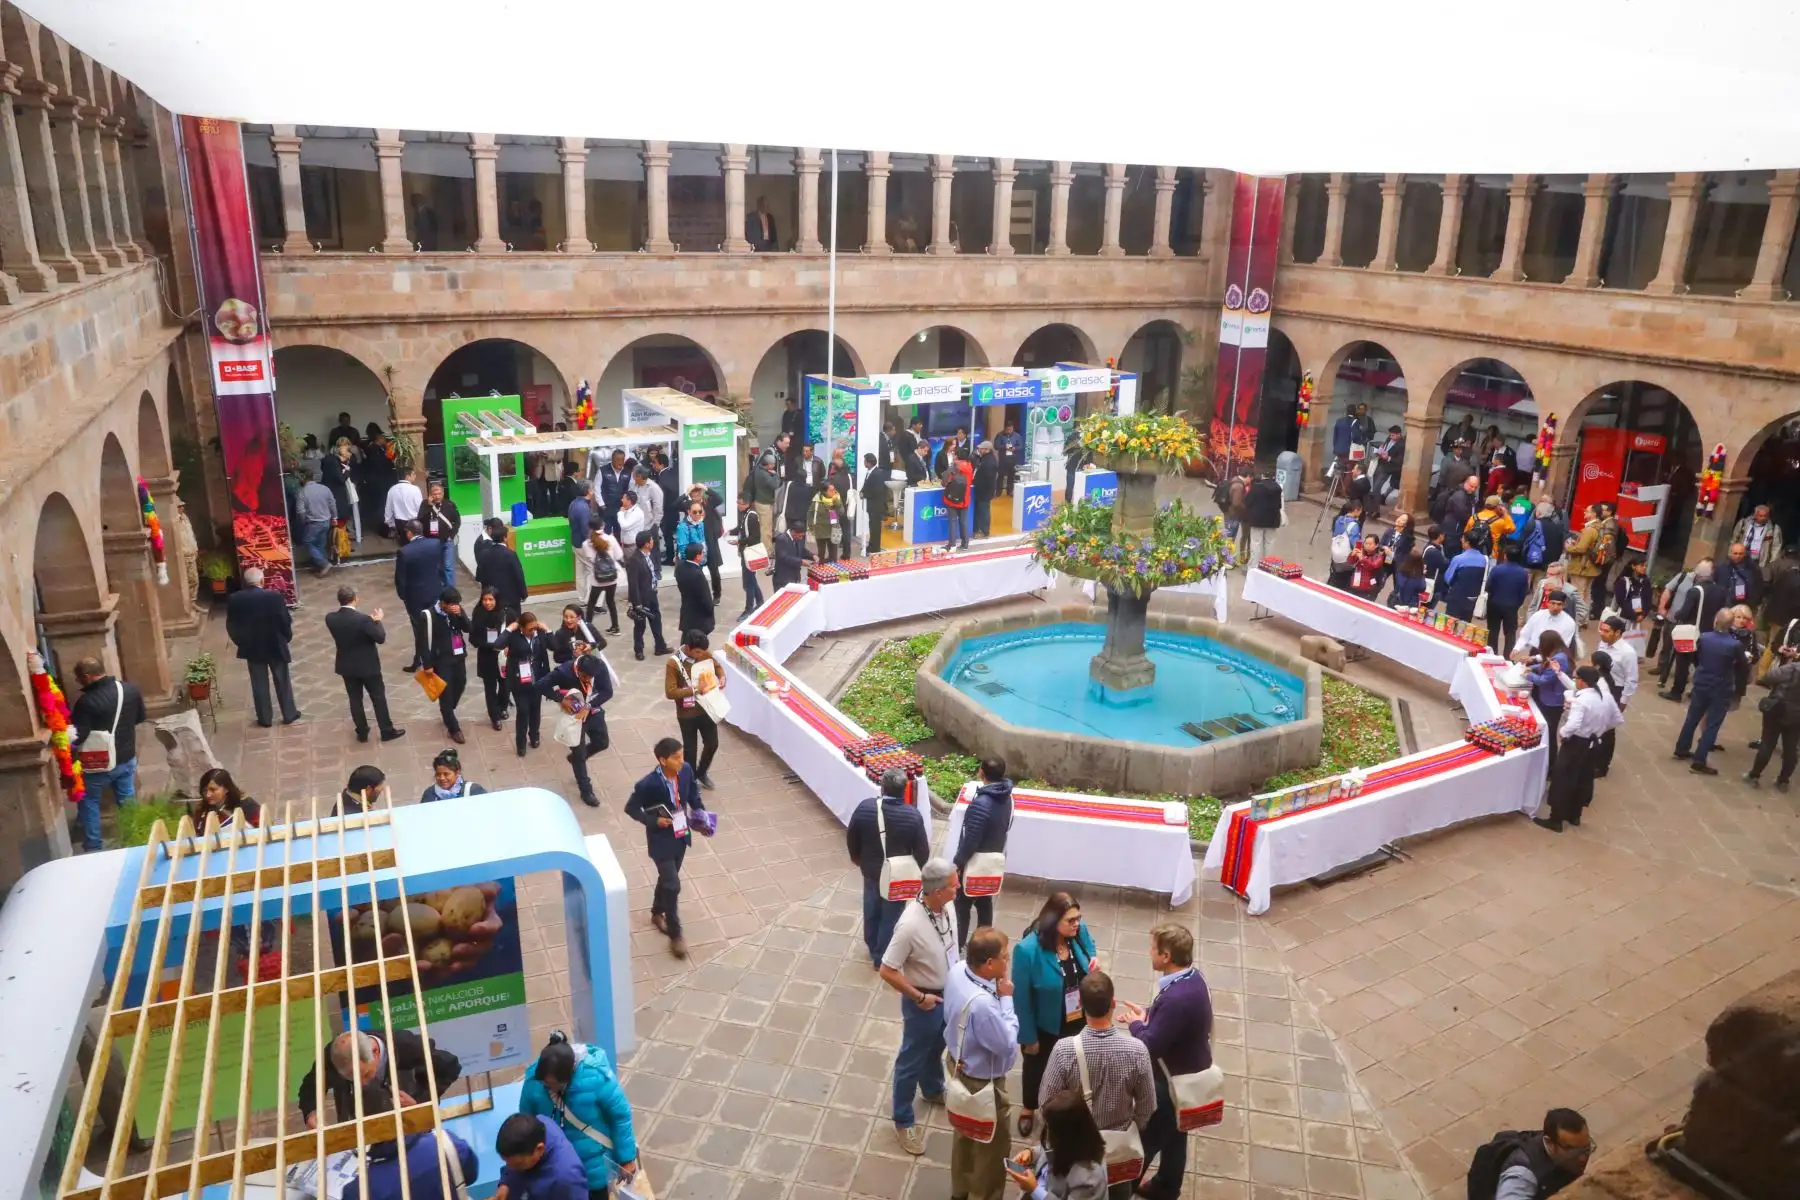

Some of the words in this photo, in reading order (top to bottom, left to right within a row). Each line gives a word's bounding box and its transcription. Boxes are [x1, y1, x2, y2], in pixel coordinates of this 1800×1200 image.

[236, 364, 258, 372] BASF
[1070, 375, 1105, 386] anasac
[913, 384, 954, 396] anasac
[994, 385, 1036, 398] anasac
[703, 427, 728, 436] BASF
[539, 538, 566, 549] BASF
